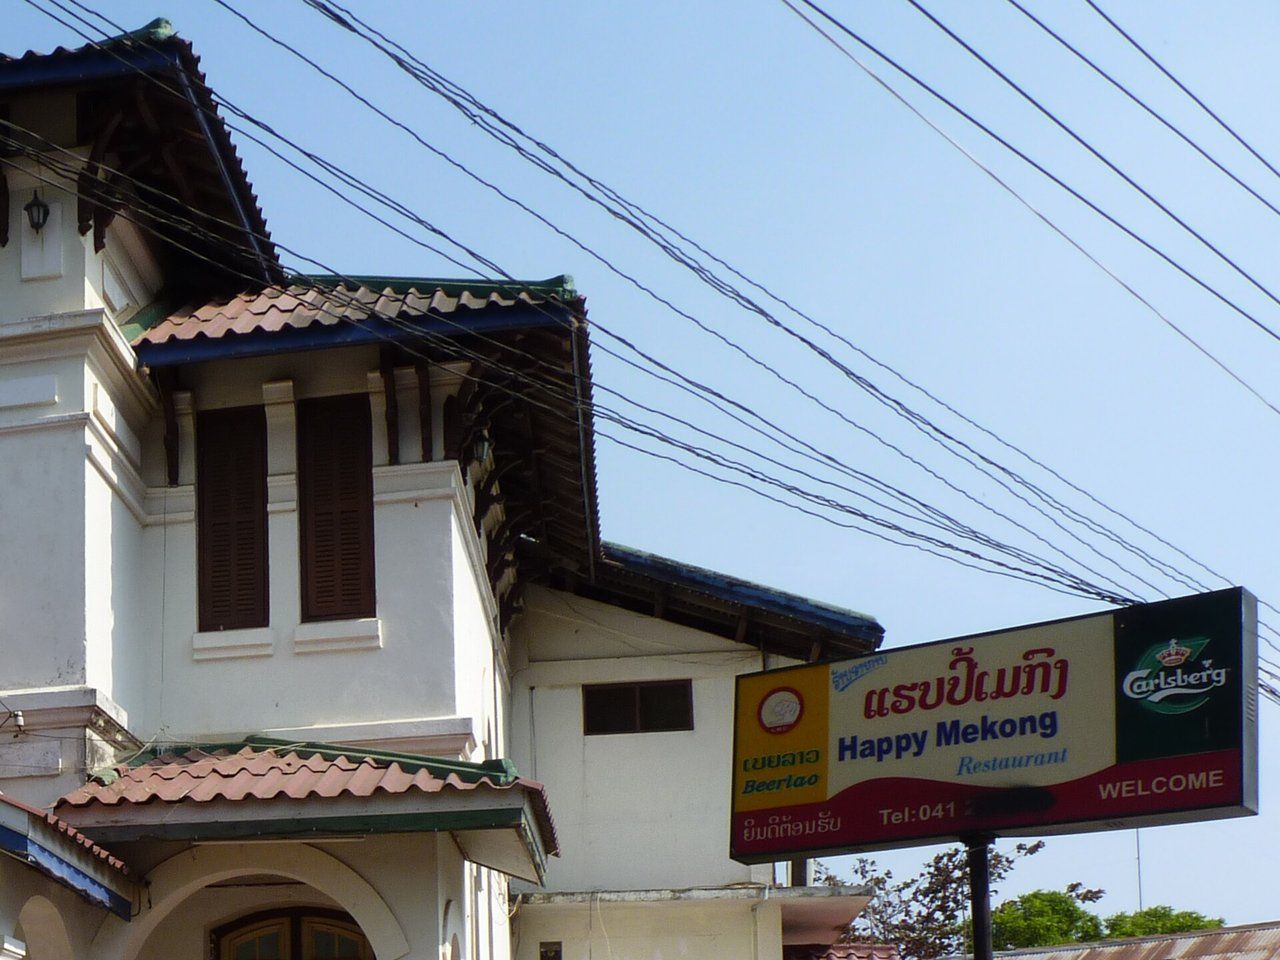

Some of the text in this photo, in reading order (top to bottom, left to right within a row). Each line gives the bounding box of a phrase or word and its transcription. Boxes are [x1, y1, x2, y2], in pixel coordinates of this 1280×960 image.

[1122, 662, 1228, 703] Carlsberg
[838, 711, 1059, 762] Happy Mekong
[743, 750, 820, 772] ເບຍລາວ
[956, 748, 1069, 776] Restaurant
[742, 773, 820, 795] Beerlao
[1098, 770, 1224, 801] WELCOME
